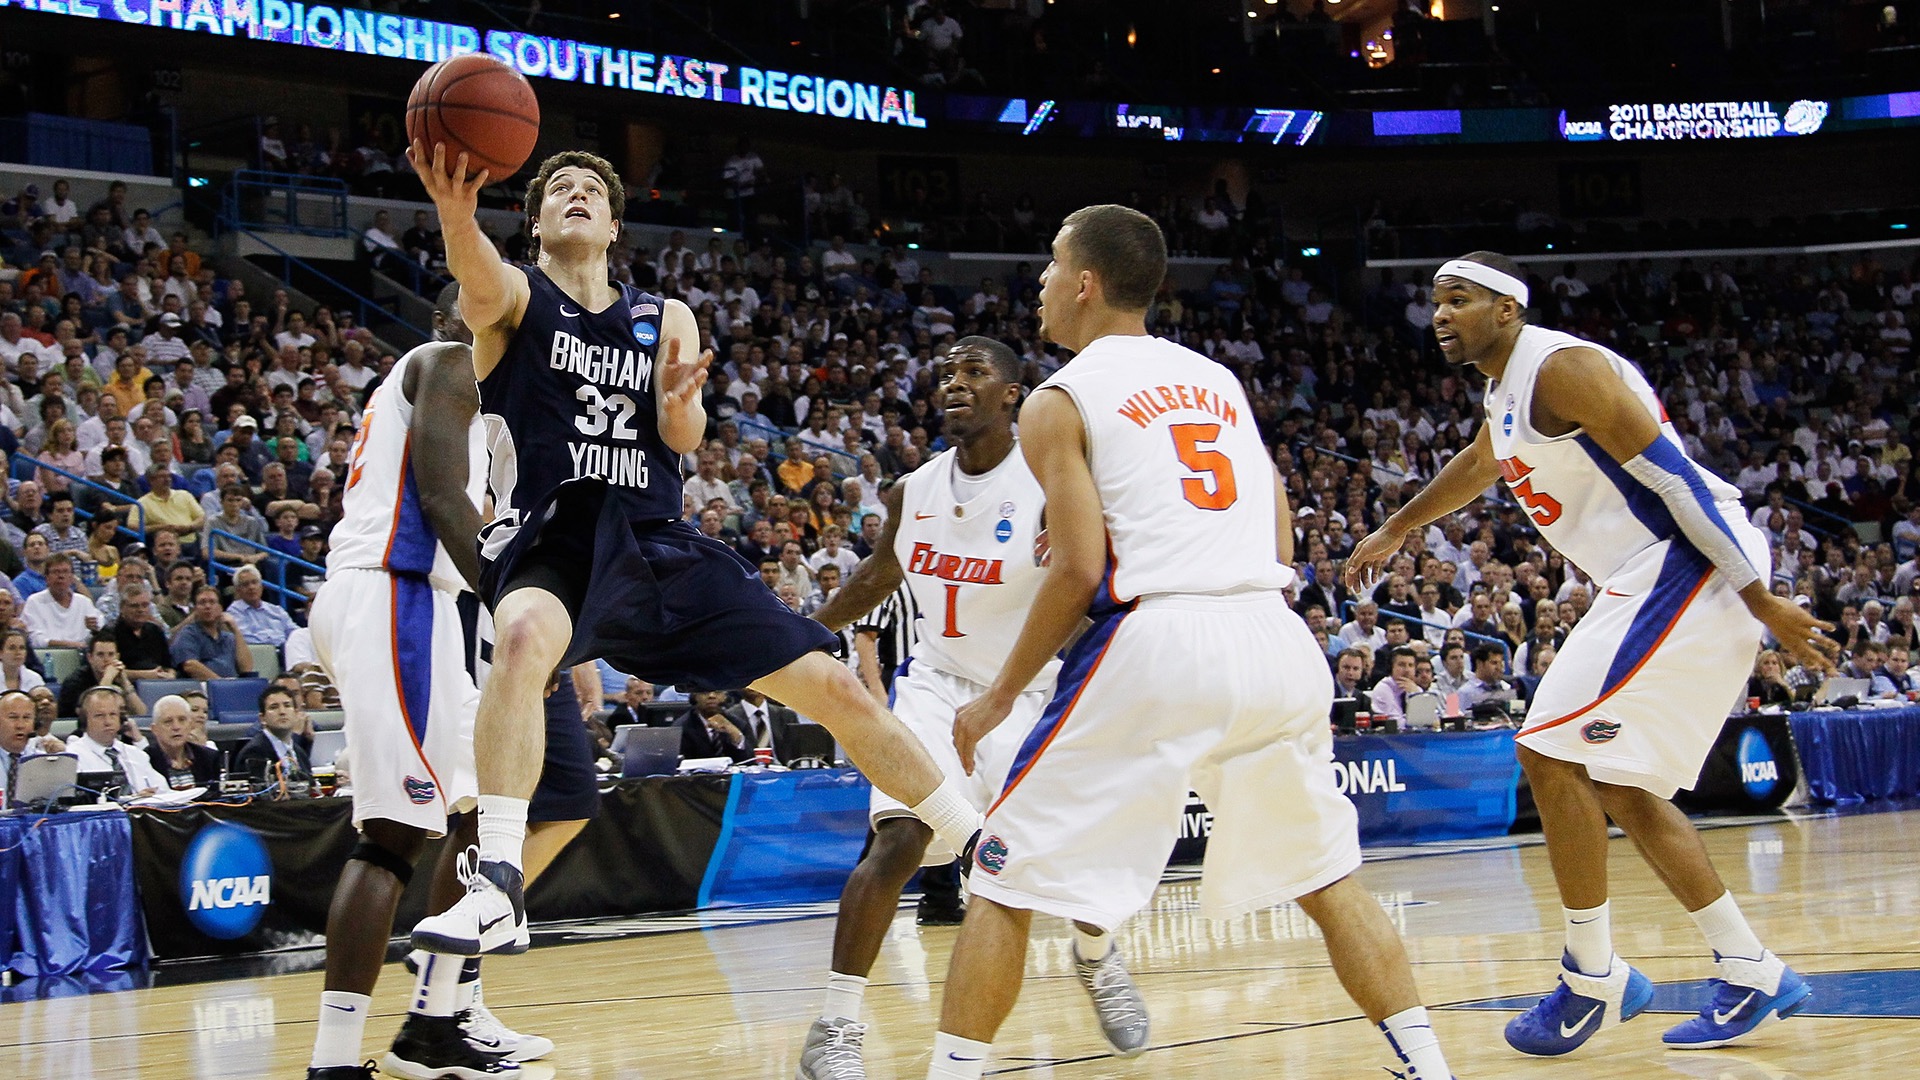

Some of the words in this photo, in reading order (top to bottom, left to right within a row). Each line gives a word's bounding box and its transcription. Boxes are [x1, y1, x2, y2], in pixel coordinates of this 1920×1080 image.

[113, 0, 481, 62] CHAMPIONSHIP
[489, 31, 728, 101] SOUTHEAST
[740, 67, 926, 128] REGIONAL
[1565, 121, 1603, 135] NCAA
[1609, 104, 1649, 121] 2011
[1653, 101, 1774, 120] BASKETBALL
[1609, 118, 1781, 141] CHAMPIONSHIP
[550, 330, 652, 393] BRIGHAM
[574, 384, 638, 441] 32
[1117, 384, 1237, 429] WILBEKIN
[567, 441, 649, 489] YOUNG
[1168, 423, 1237, 511] 5
[942, 584, 967, 638] 1
[1742, 760, 1778, 783] NCAA
[189, 874, 271, 911] NCAA
